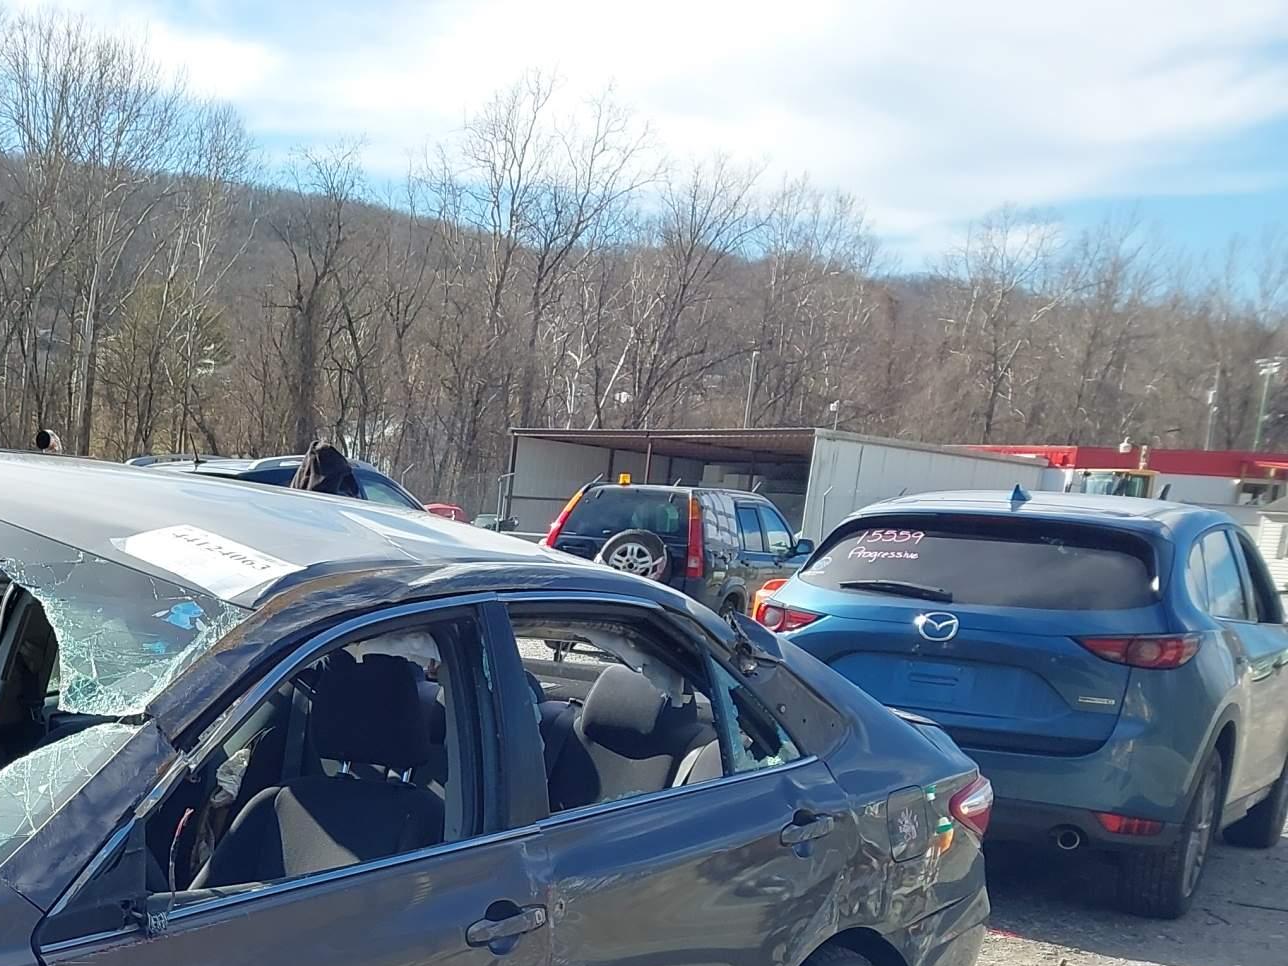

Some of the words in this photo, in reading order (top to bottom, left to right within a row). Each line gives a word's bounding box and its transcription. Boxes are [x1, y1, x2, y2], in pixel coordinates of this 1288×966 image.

[856, 530, 925, 545] 15559
[172, 532, 271, 570] 44124063
[848, 546, 920, 562] Progressive
